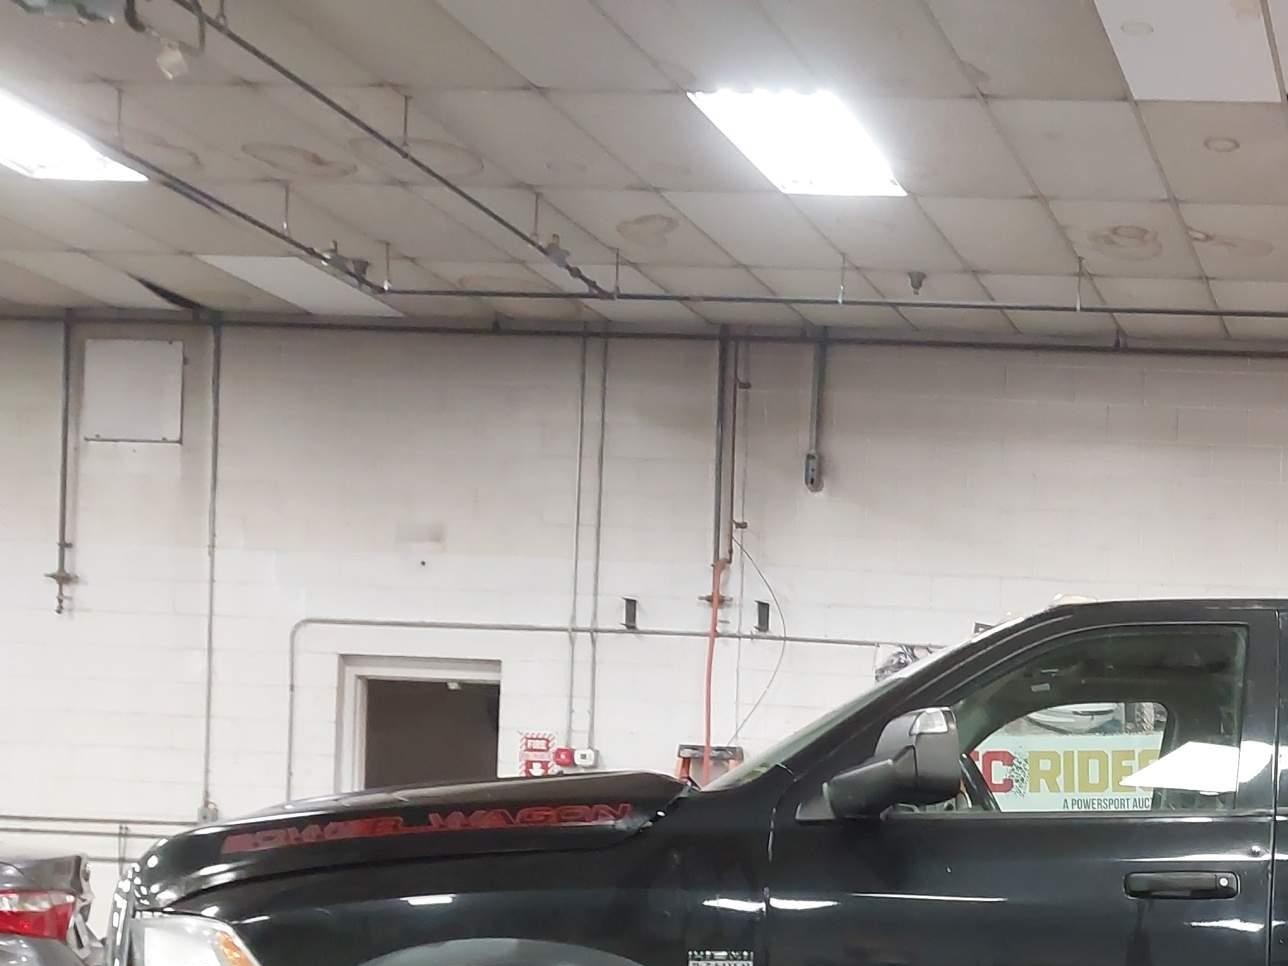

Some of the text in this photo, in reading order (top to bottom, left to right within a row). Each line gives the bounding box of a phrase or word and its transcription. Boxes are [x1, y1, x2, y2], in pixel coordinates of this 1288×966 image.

[968, 750, 1016, 793] C
[1063, 797, 1152, 810] A POWERSPORT AUC
